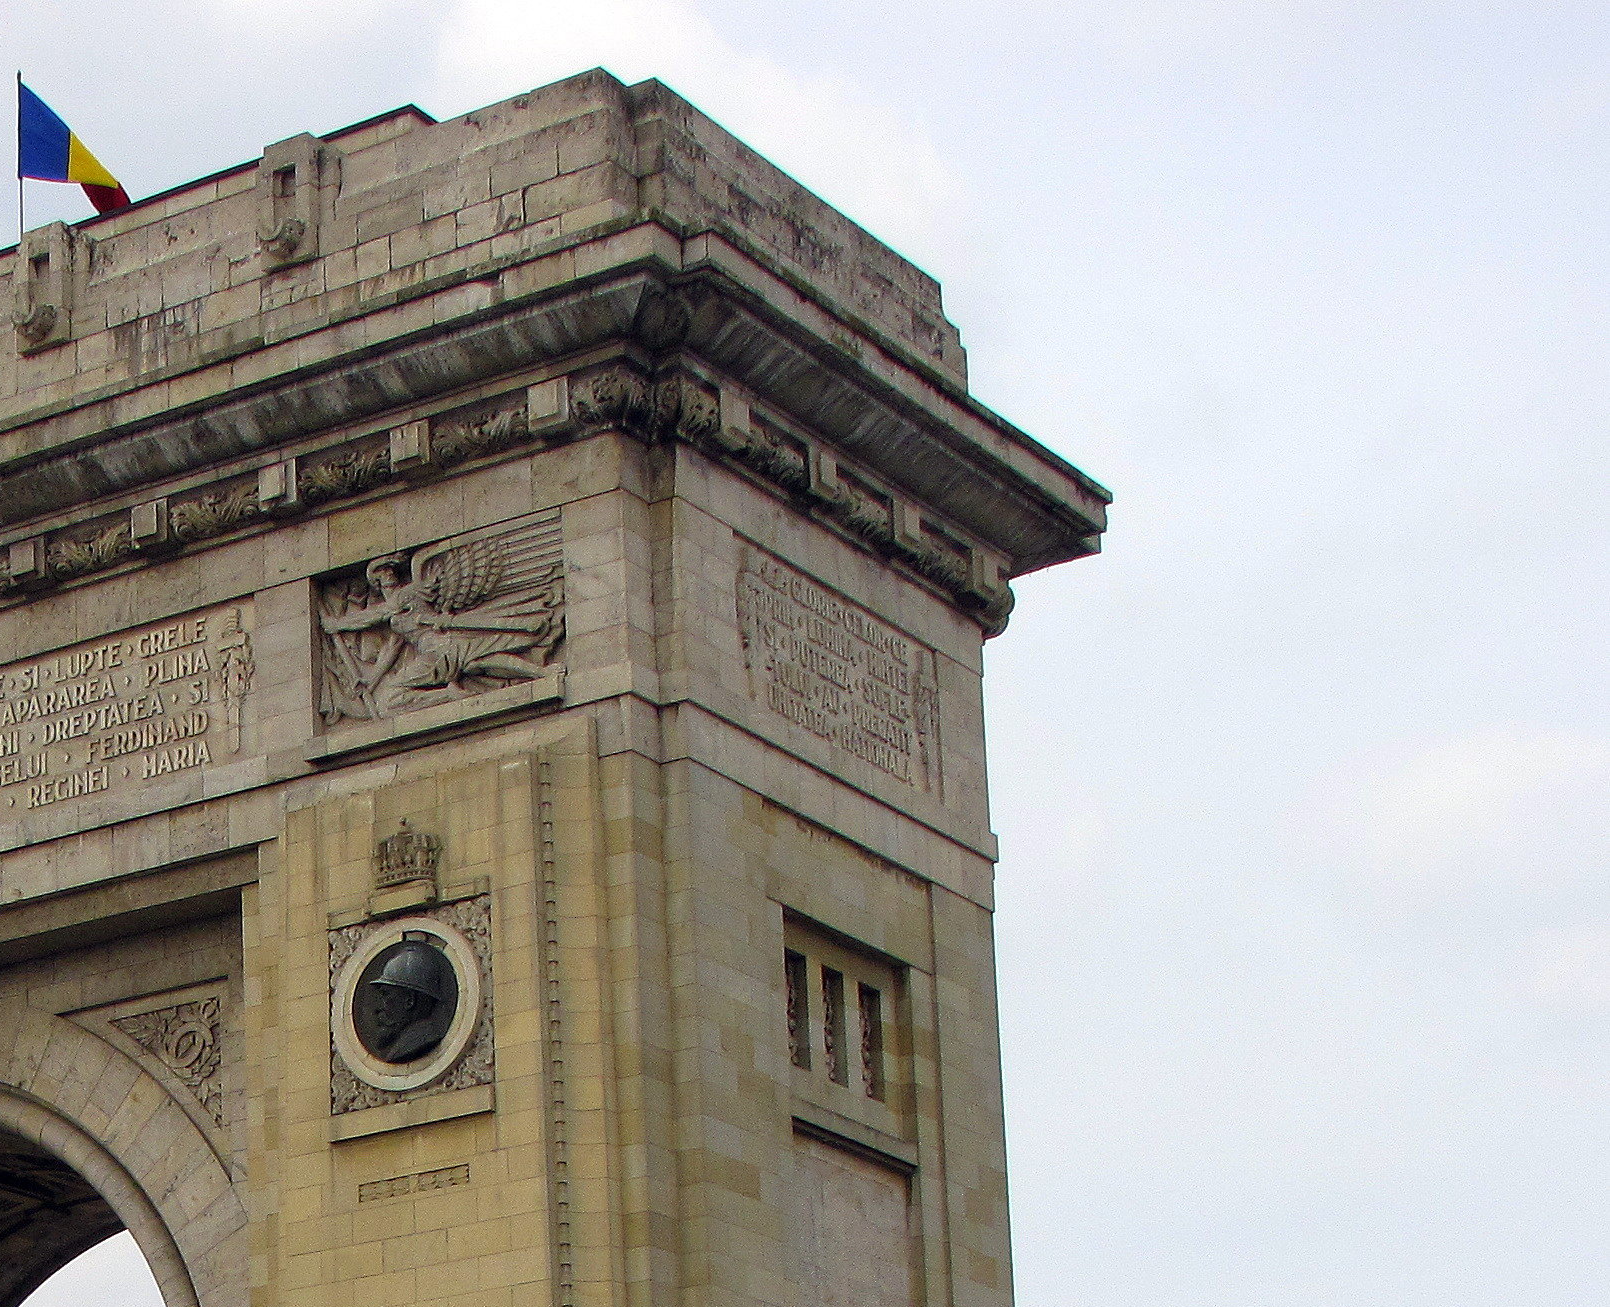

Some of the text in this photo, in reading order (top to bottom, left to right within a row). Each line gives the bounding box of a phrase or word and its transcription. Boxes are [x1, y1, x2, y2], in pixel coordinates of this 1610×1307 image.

[2, 674, 116, 727] APARAREA
[145, 649, 210, 688] PLINA
[21, 665, 41, 692] SI
[55, 642, 122, 683] LUPTE
[138, 617, 207, 658] GRELE
[43, 690, 164, 746] DREPTATEA
[189, 678, 210, 705] SI
[87, 709, 209, 764] FERDINAND
[27, 765, 110, 809] REGINEI
[142, 740, 212, 780] MARIA
